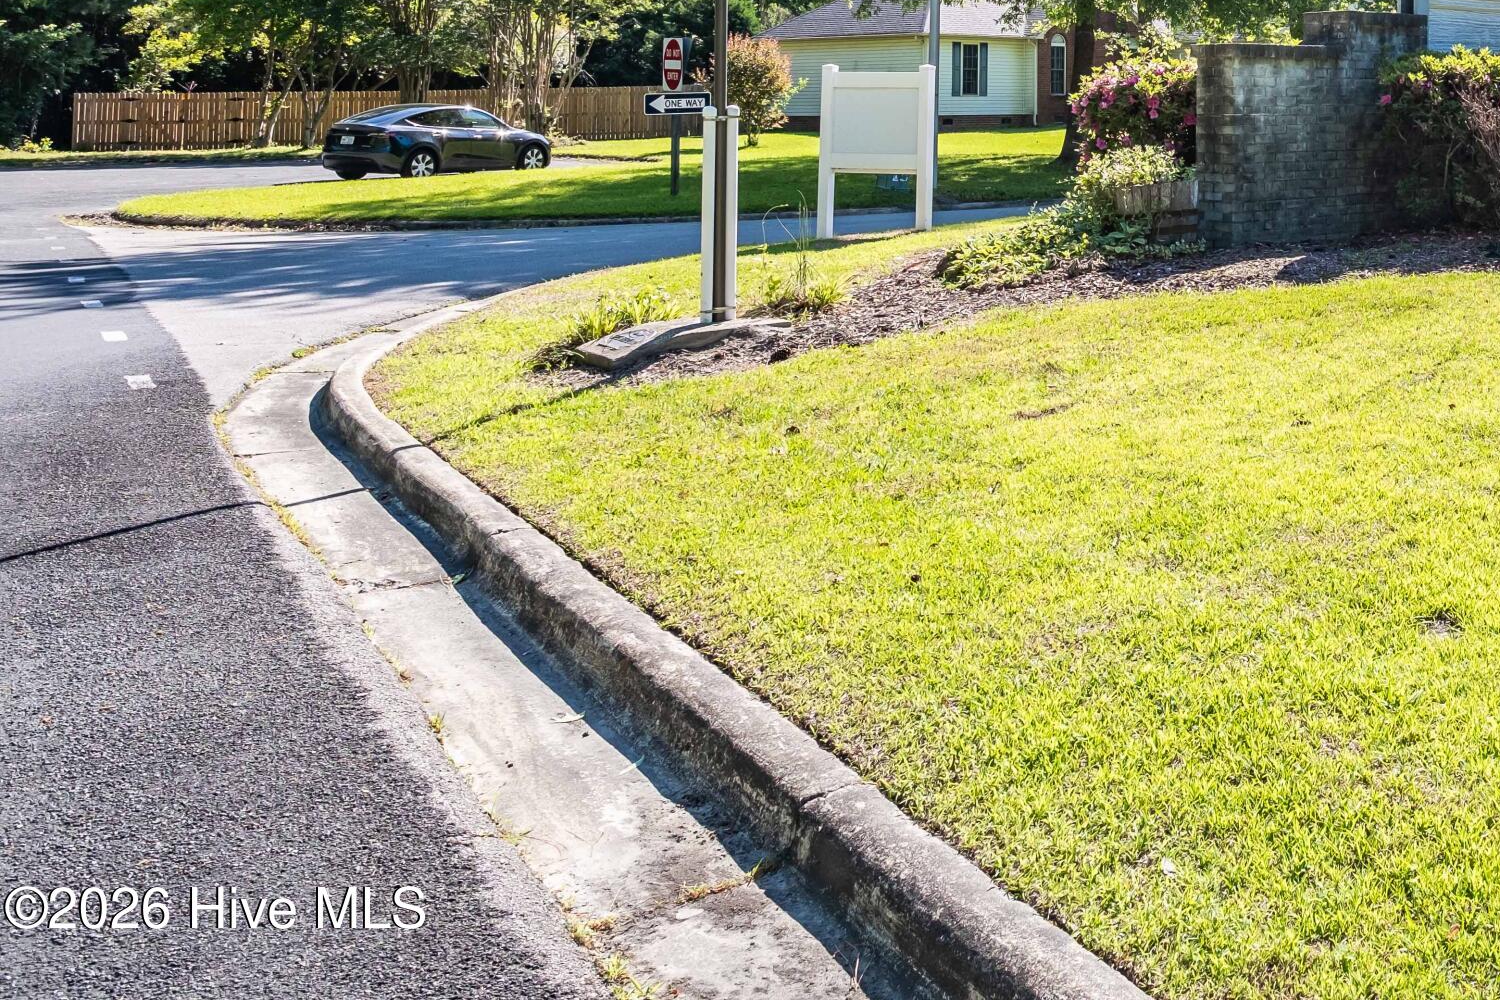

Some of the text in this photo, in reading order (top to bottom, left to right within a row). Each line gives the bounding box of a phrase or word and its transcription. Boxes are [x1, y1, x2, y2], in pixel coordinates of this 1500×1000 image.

[666, 49, 672, 57] DO
[667, 72, 679, 80] ENTER
[685, 99, 703, 107] WAY
